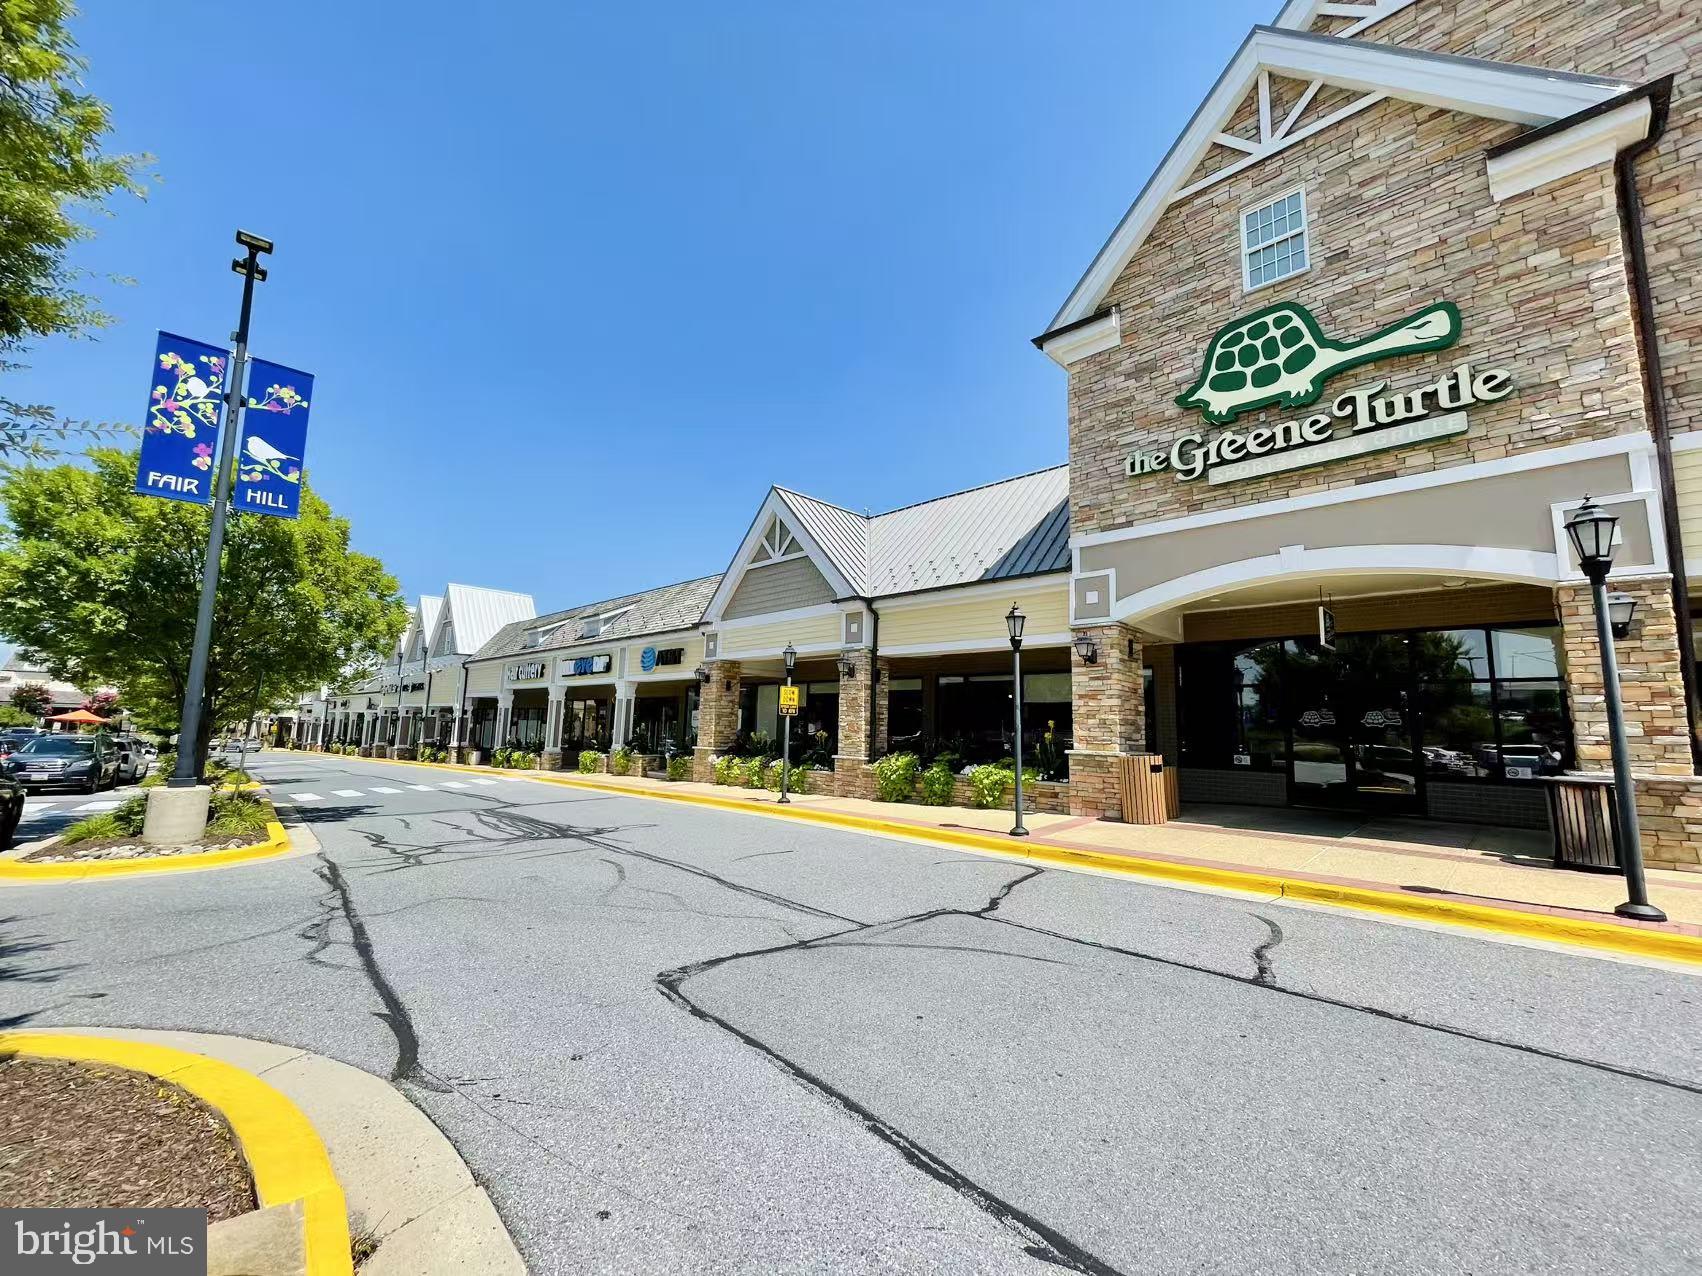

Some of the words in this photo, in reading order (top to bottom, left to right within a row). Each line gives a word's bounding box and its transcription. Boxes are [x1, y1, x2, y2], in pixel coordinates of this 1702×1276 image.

[1125, 449, 1168, 477] the
[1171, 413, 1333, 482] Greene
[1332, 363, 1514, 432] Turtle
[1213, 453, 1290, 481] SPORTS
[1296, 444, 1345, 463] BAR
[1373, 418, 1462, 445] GRILLE
[147, 471, 200, 495] FAIR
[246, 488, 289, 509] HILL
